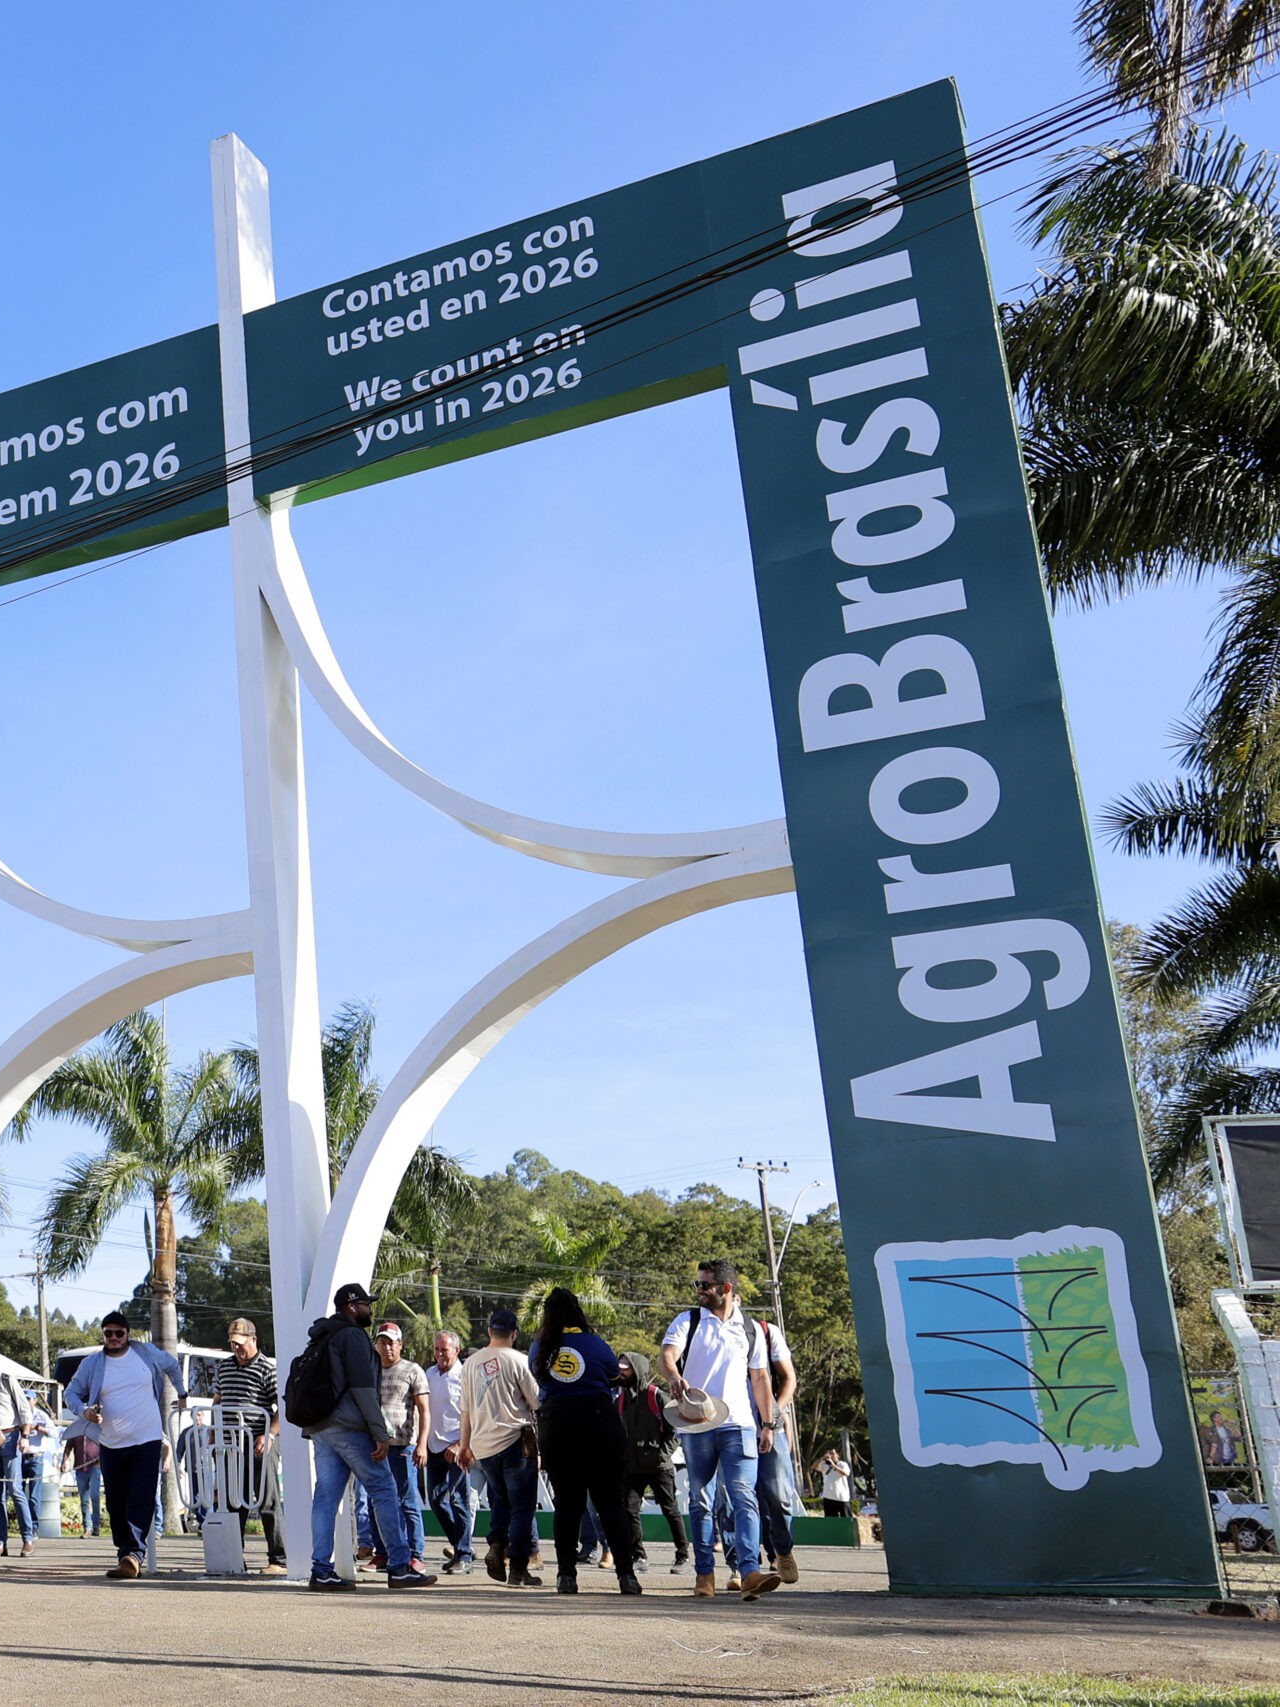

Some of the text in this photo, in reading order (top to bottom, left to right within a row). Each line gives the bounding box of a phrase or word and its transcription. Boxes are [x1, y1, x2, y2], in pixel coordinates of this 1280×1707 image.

[322, 215, 595, 319] Contamos con
[326, 247, 599, 356] usted en 2026
[96, 386, 189, 435] com
[343, 322, 586, 412] We count on
[353, 357, 583, 457] you in 2026
[69, 442, 181, 507] 2026
[738, 159, 1091, 1143] AgroBrasília
